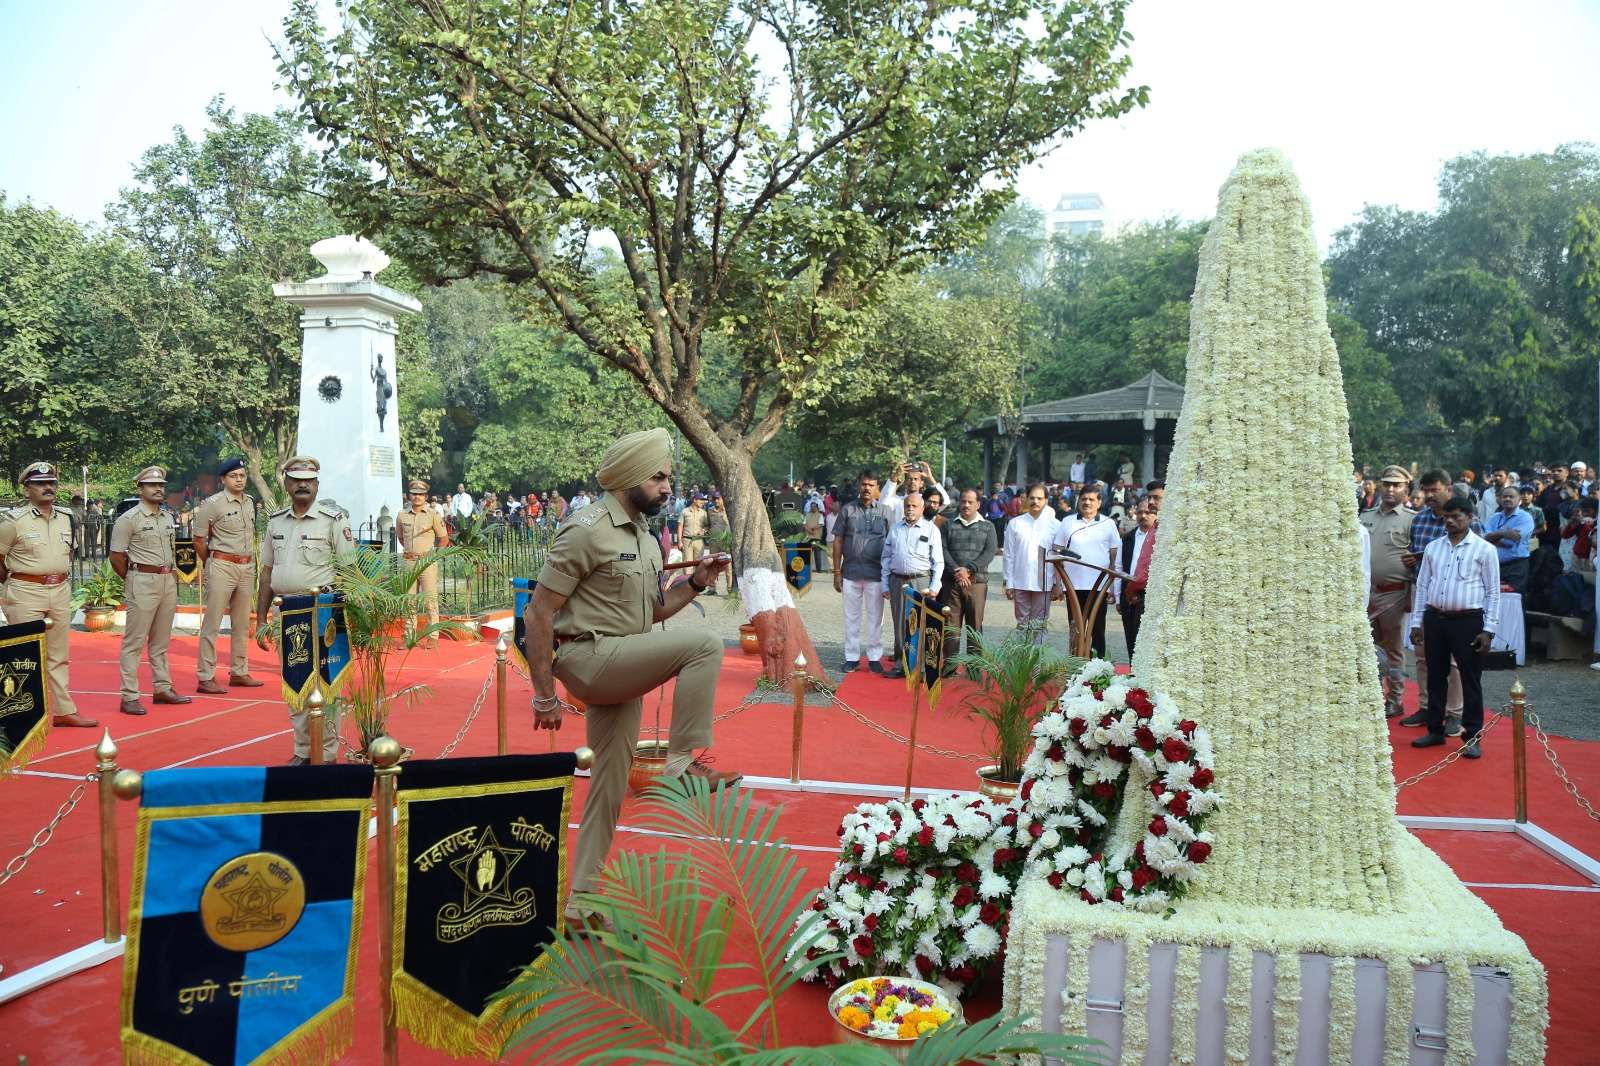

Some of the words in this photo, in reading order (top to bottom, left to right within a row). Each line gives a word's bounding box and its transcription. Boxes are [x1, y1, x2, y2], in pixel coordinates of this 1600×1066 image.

[12, 658, 37, 671] पोलीस
[414, 826, 478, 872] महाराष्ट्र
[509, 816, 556, 852] पोलीस
[178, 979, 220, 1014] पुणे
[228, 971, 302, 998] पोलीस
